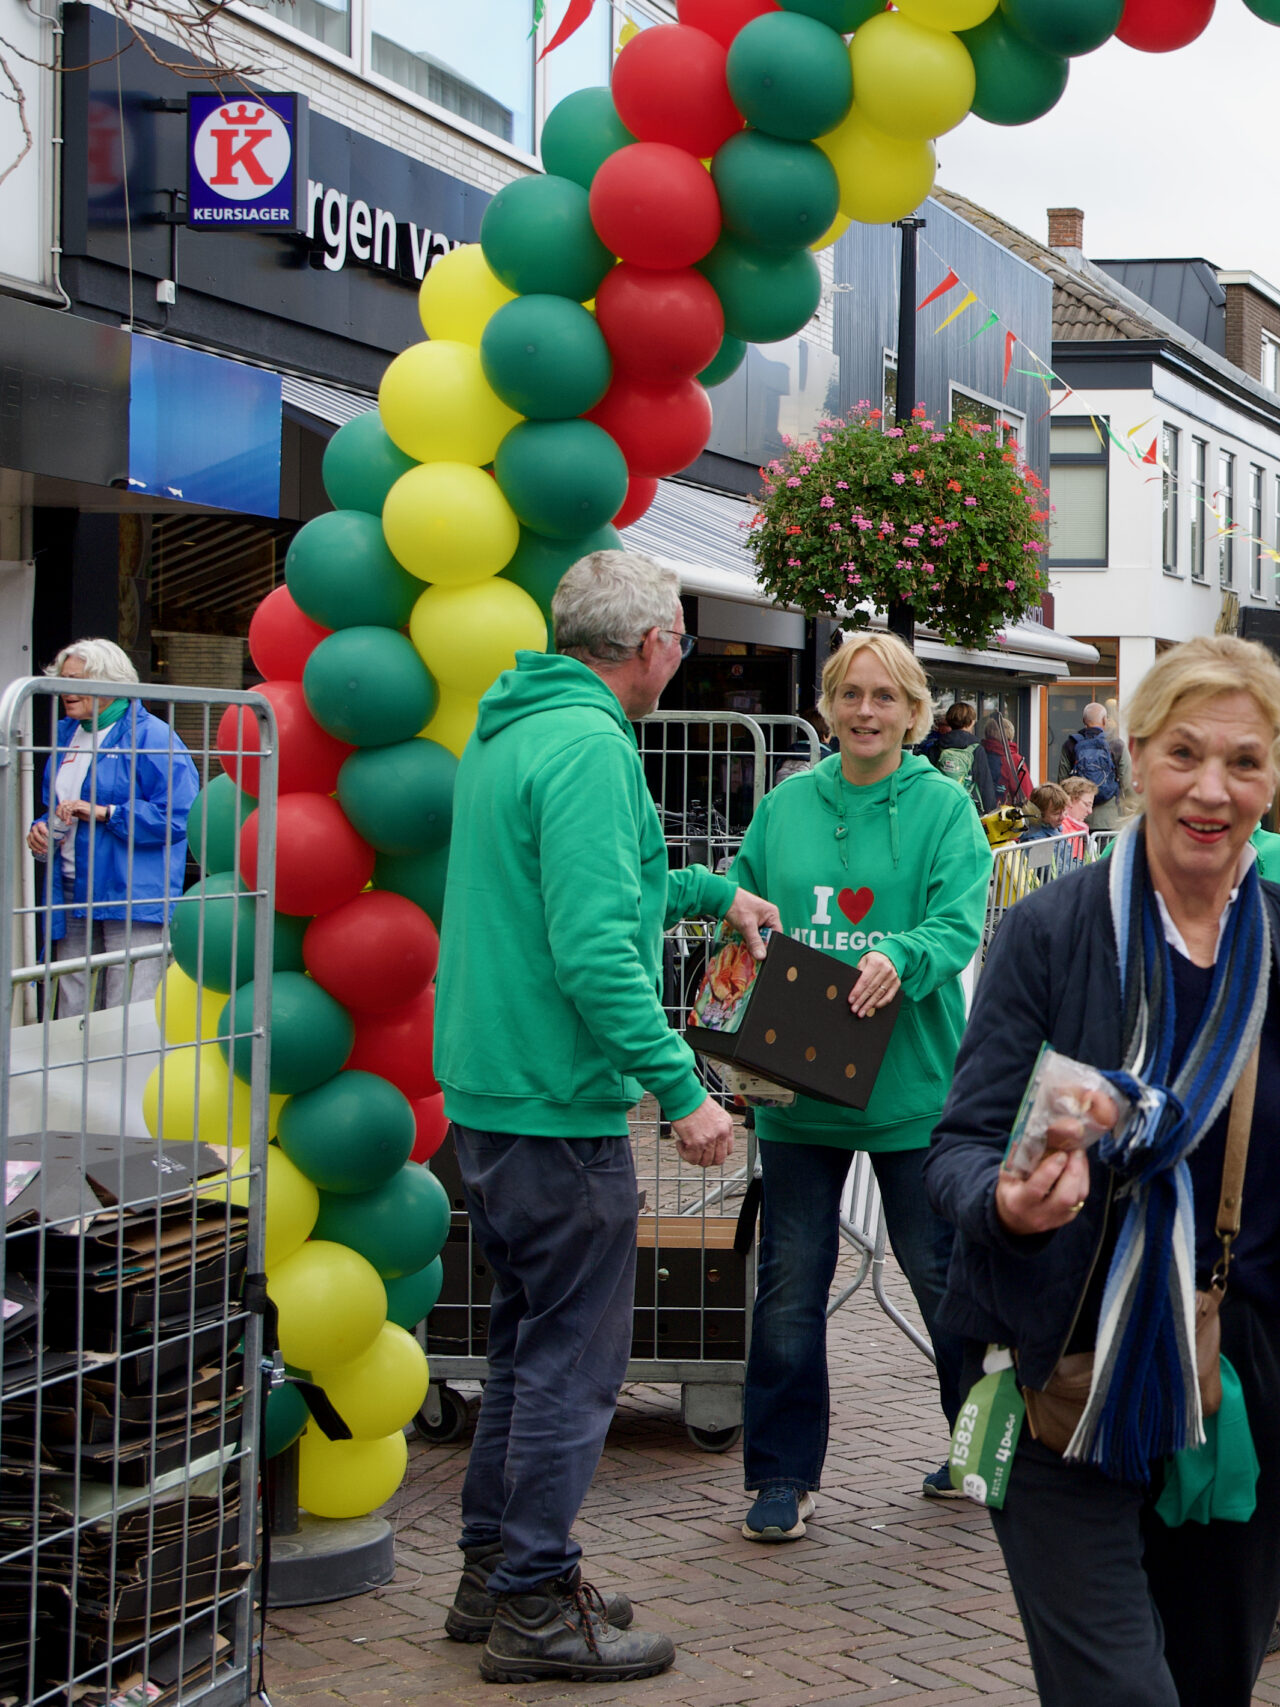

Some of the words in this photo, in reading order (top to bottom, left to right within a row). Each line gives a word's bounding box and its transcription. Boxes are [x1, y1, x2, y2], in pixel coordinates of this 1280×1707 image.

[210, 129, 274, 185] K
[194, 208, 290, 221] KEURSLAGER
[409, 222, 468, 281] va
[811, 886, 835, 925] I
[790, 927, 905, 951] HILLEGO
[951, 1403, 979, 1467] 15825
